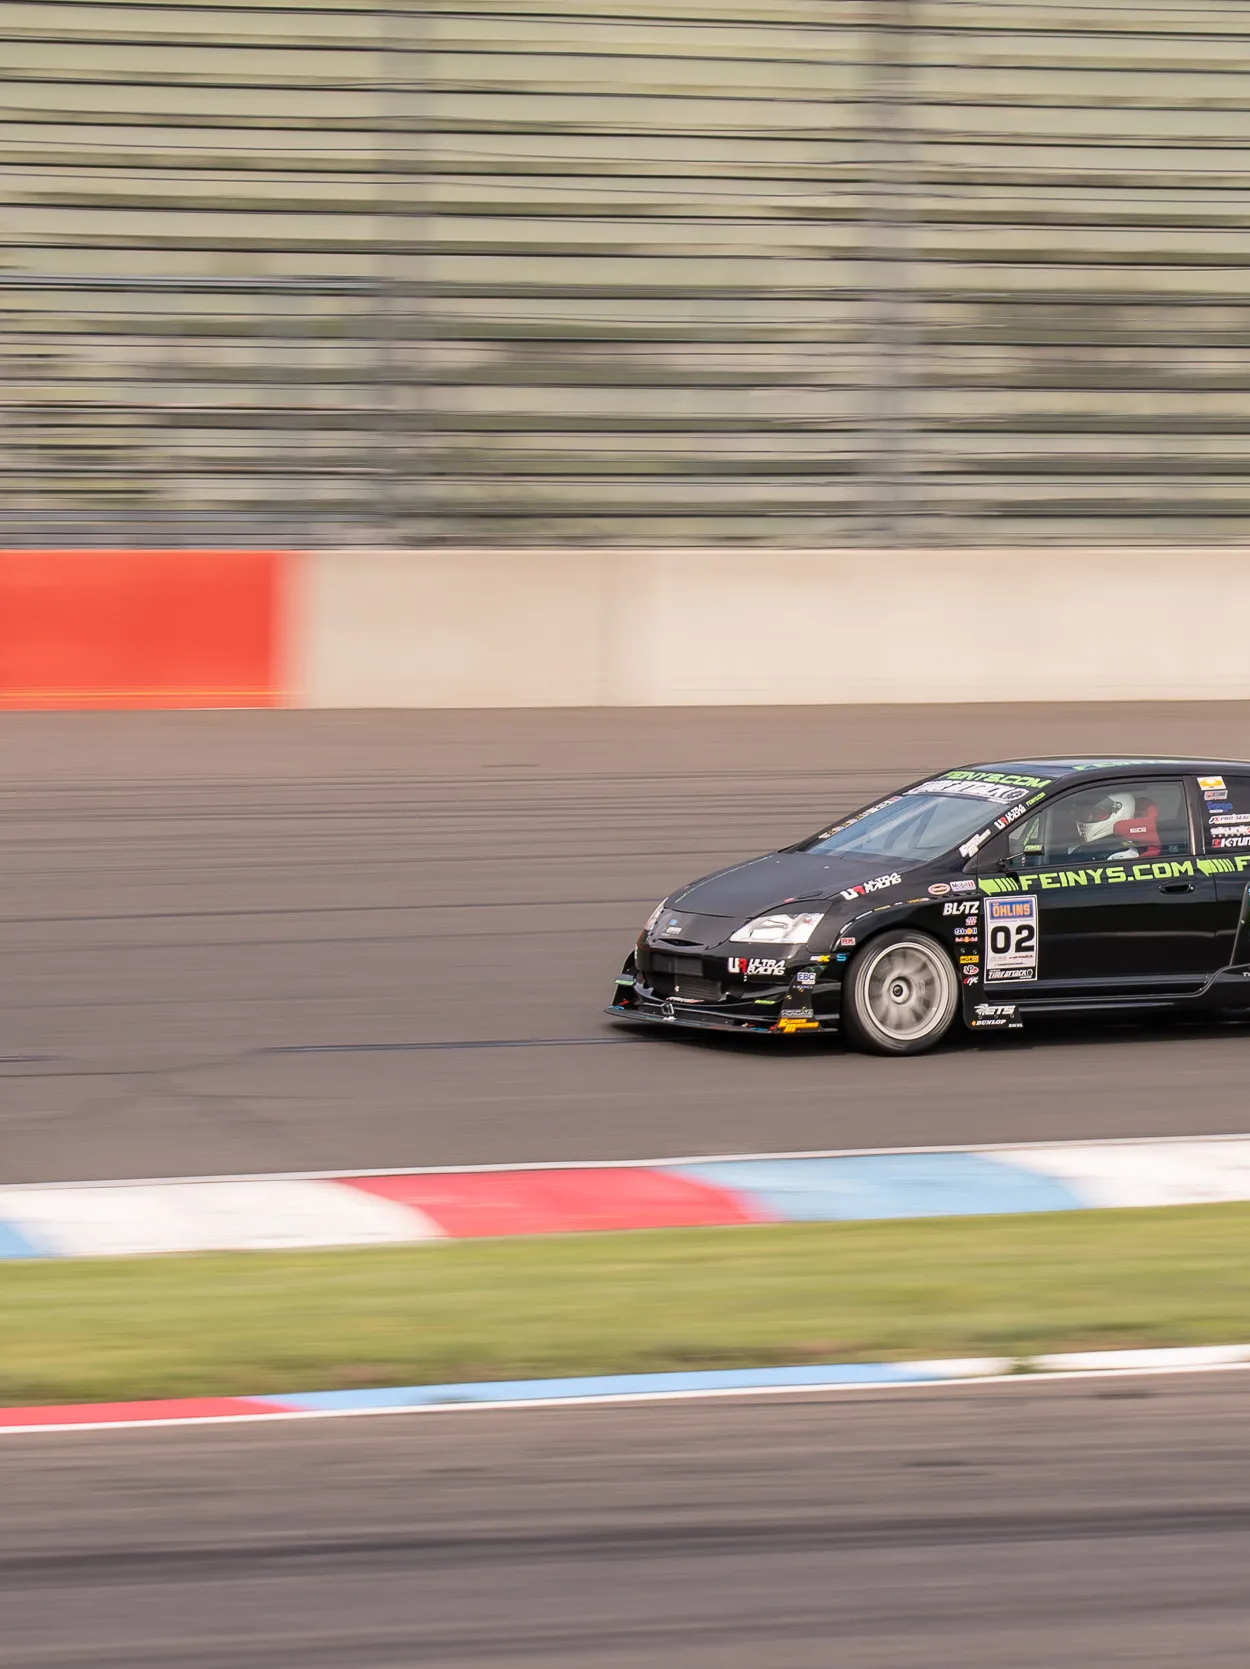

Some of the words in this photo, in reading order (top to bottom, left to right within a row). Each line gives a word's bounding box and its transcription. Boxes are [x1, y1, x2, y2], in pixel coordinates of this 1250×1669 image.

[1018, 861, 1194, 890] FEINYS.COM
[942, 901, 979, 916] BLITZ
[992, 902, 1031, 918] ÖHLINS
[991, 924, 1035, 954] 02
[748, 958, 785, 967] ULTRA
[747, 966, 785, 976] RACING
